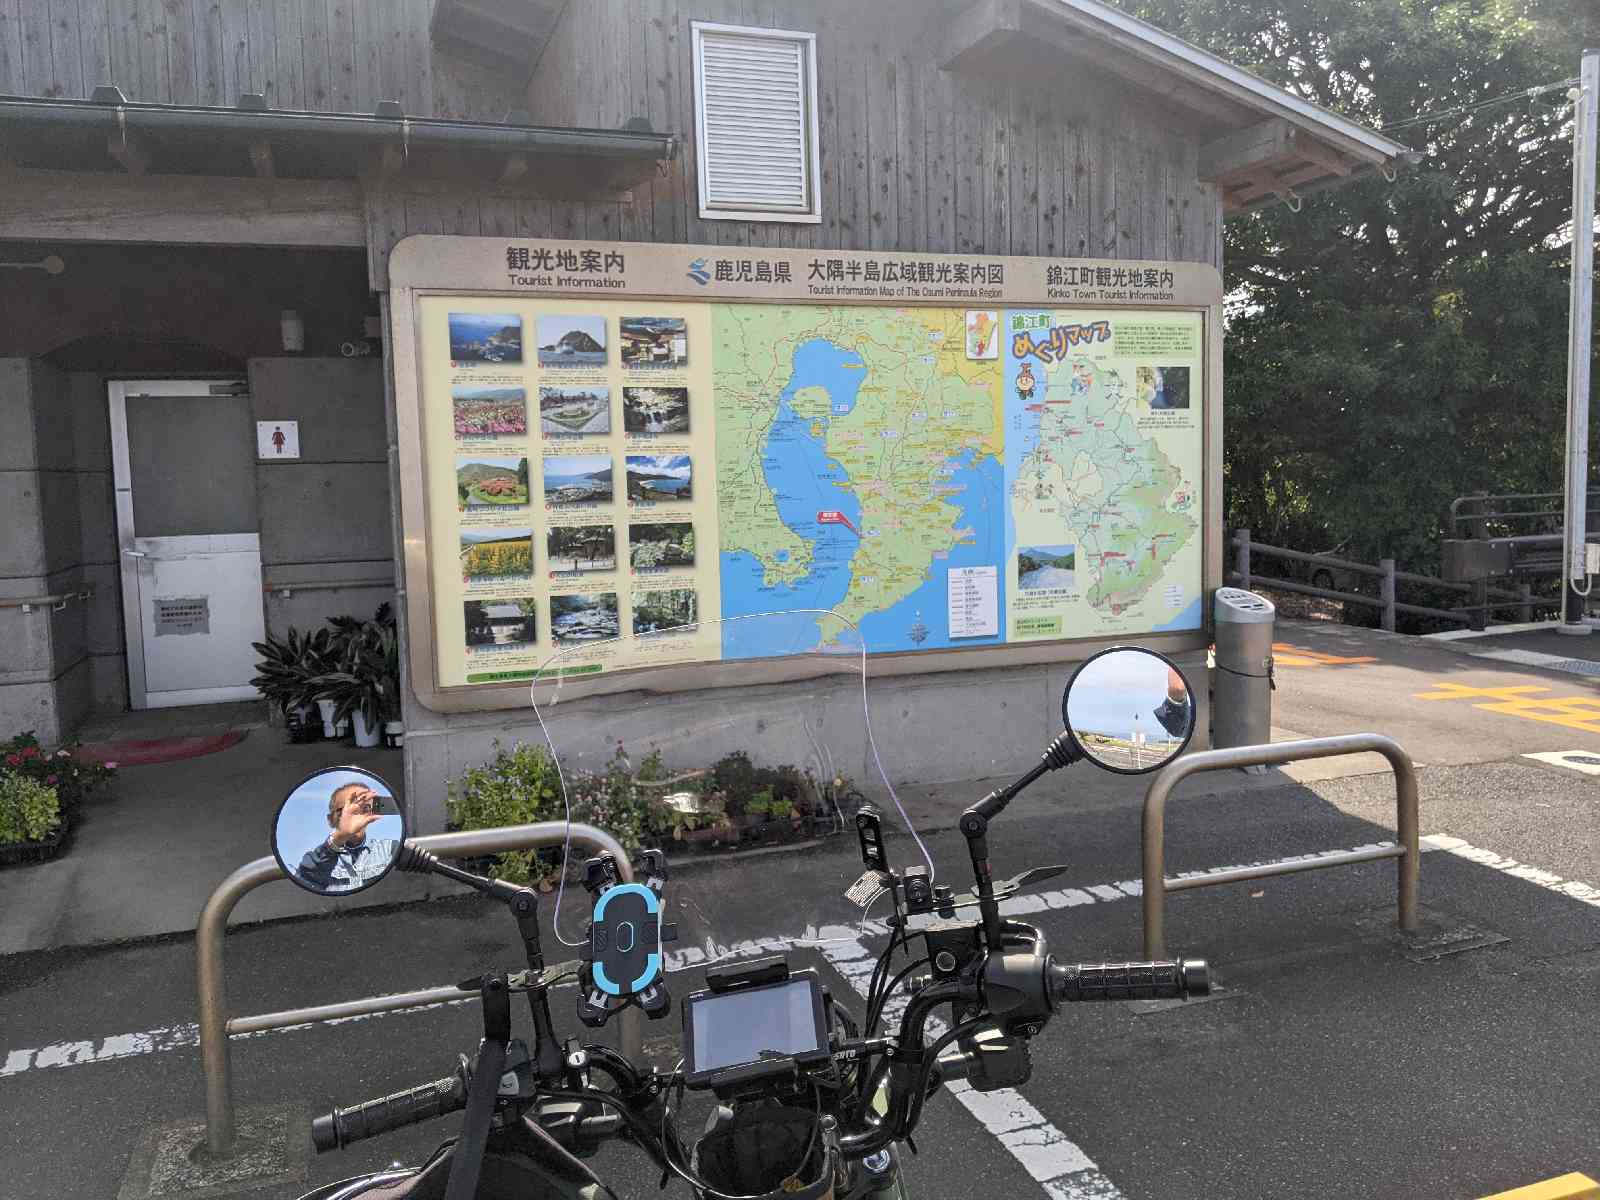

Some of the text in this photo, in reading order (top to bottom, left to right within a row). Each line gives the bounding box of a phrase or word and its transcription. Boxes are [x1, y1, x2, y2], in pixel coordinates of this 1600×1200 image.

[506, 246, 625, 273] 観光地案内
[715, 258, 1004, 284] 鹿児島県 大隅半島広域観光案内図
[1046, 265, 1174, 288] 錦江町観光地案内
[508, 274, 626, 288] Tourist Information
[807, 284, 834, 295] Tourist
[836, 285, 878, 296] Information
[880, 286, 895, 297] Map
[896, 286, 905, 296] of
[906, 287, 920, 296] The
[978, 288, 1003, 299] Region
[1047, 288, 1174, 301] Kinko Town Tourist Information
